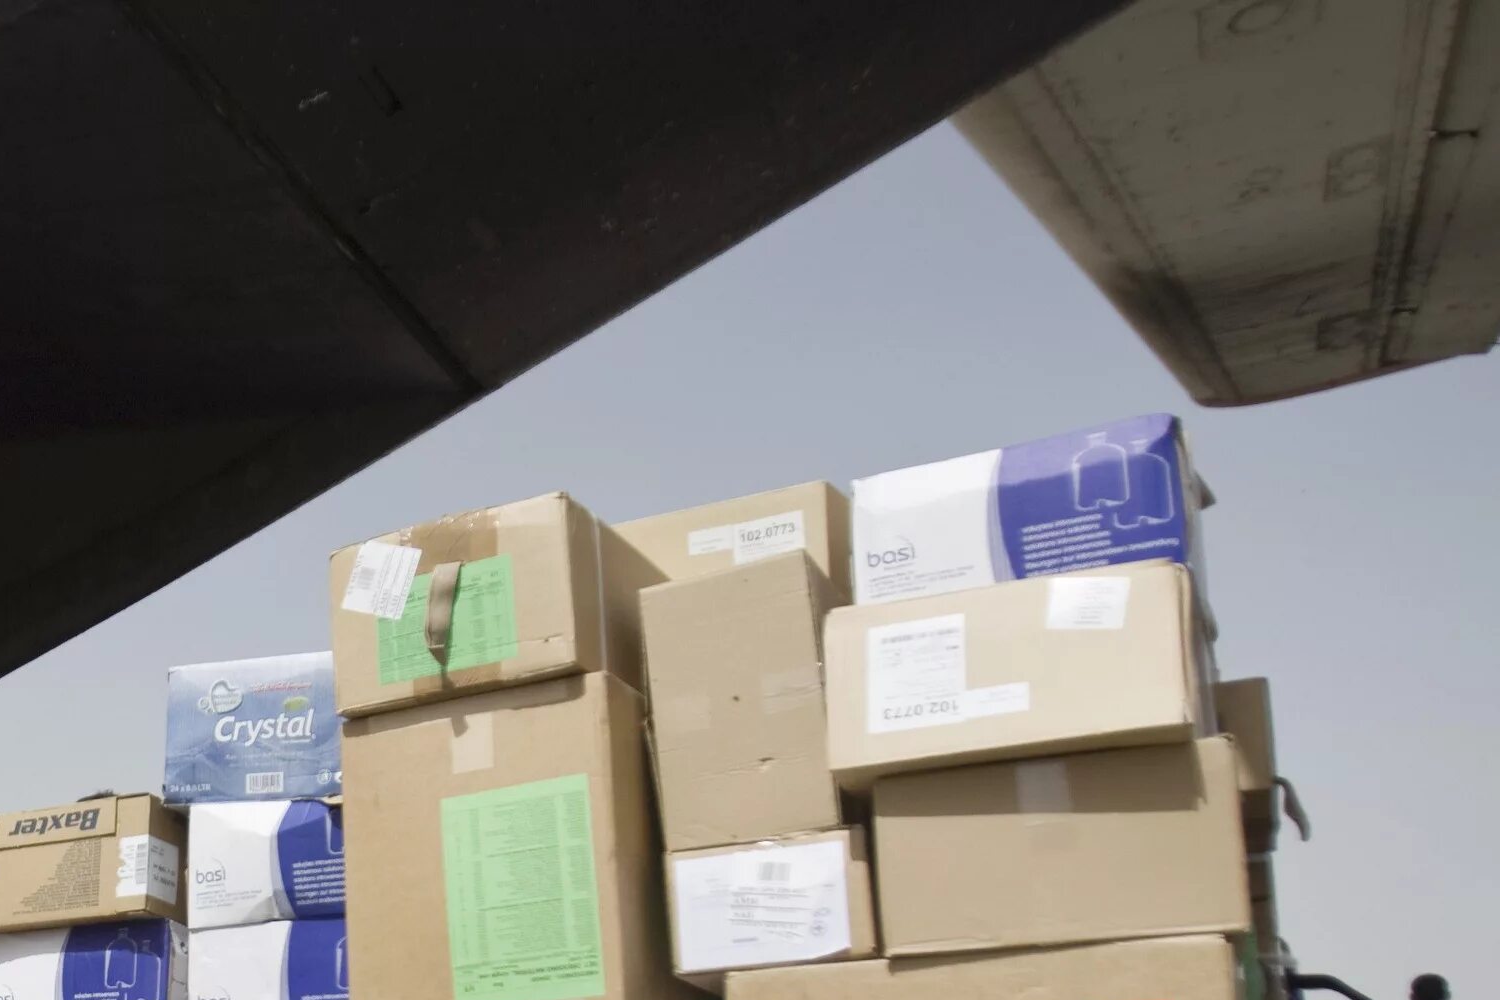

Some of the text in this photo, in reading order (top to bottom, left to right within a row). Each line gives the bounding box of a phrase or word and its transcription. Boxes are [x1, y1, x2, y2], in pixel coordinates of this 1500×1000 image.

[740, 522, 796, 543] 102.0773
[866, 543, 916, 569] basi
[214, 707, 315, 747] Crystal
[8, 807, 101, 836] Baxter
[195, 865, 227, 884] basi
